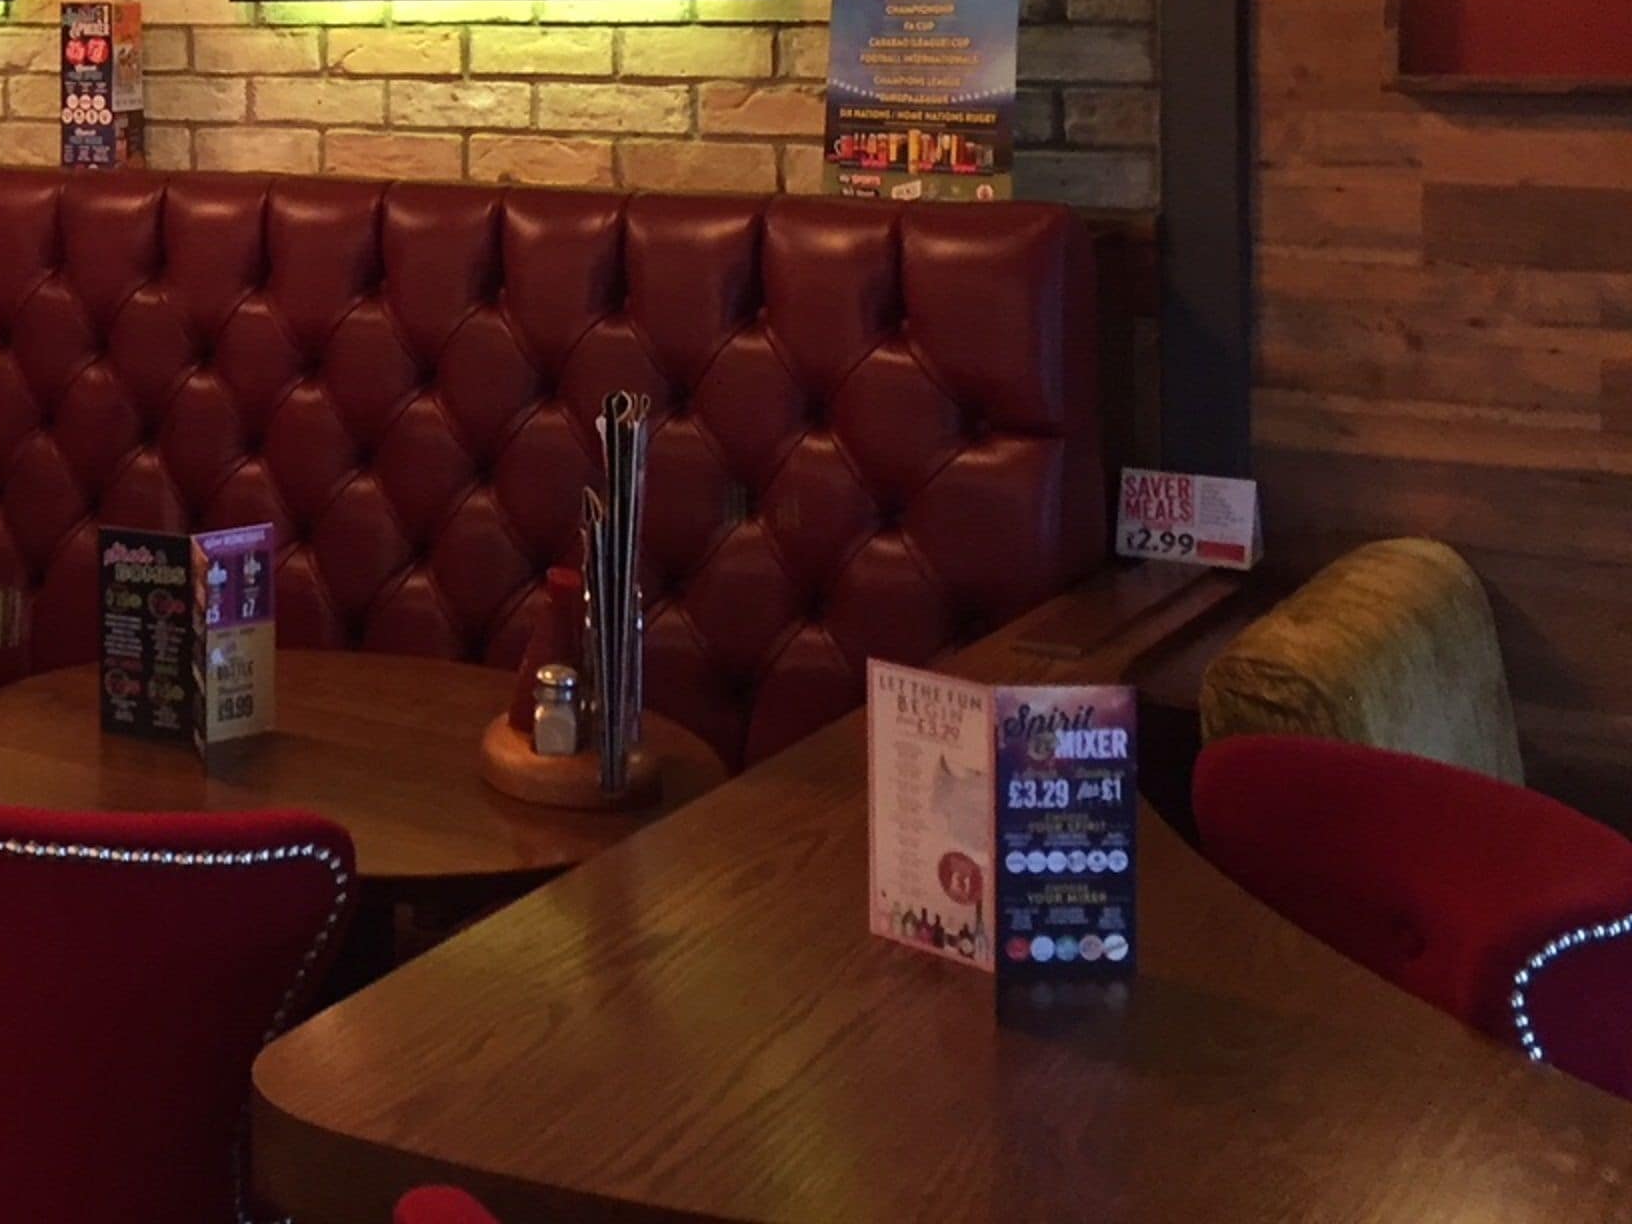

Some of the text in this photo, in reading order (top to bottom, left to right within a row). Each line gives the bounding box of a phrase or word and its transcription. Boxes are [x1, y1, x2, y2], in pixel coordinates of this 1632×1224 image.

[1124, 474, 1191, 499] SAVER
[1125, 499, 1193, 524] MEALS
[1126, 528, 1195, 556] £2.99
[911, 681, 943, 703] THE
[218, 693, 254, 722] £9.99
[896, 694, 963, 724] BEGIN
[1002, 703, 1096, 738] Spirit
[1054, 727, 1128, 760] MIXER
[1007, 778, 1070, 809] £3.29
[1101, 776, 1122, 801] £1
